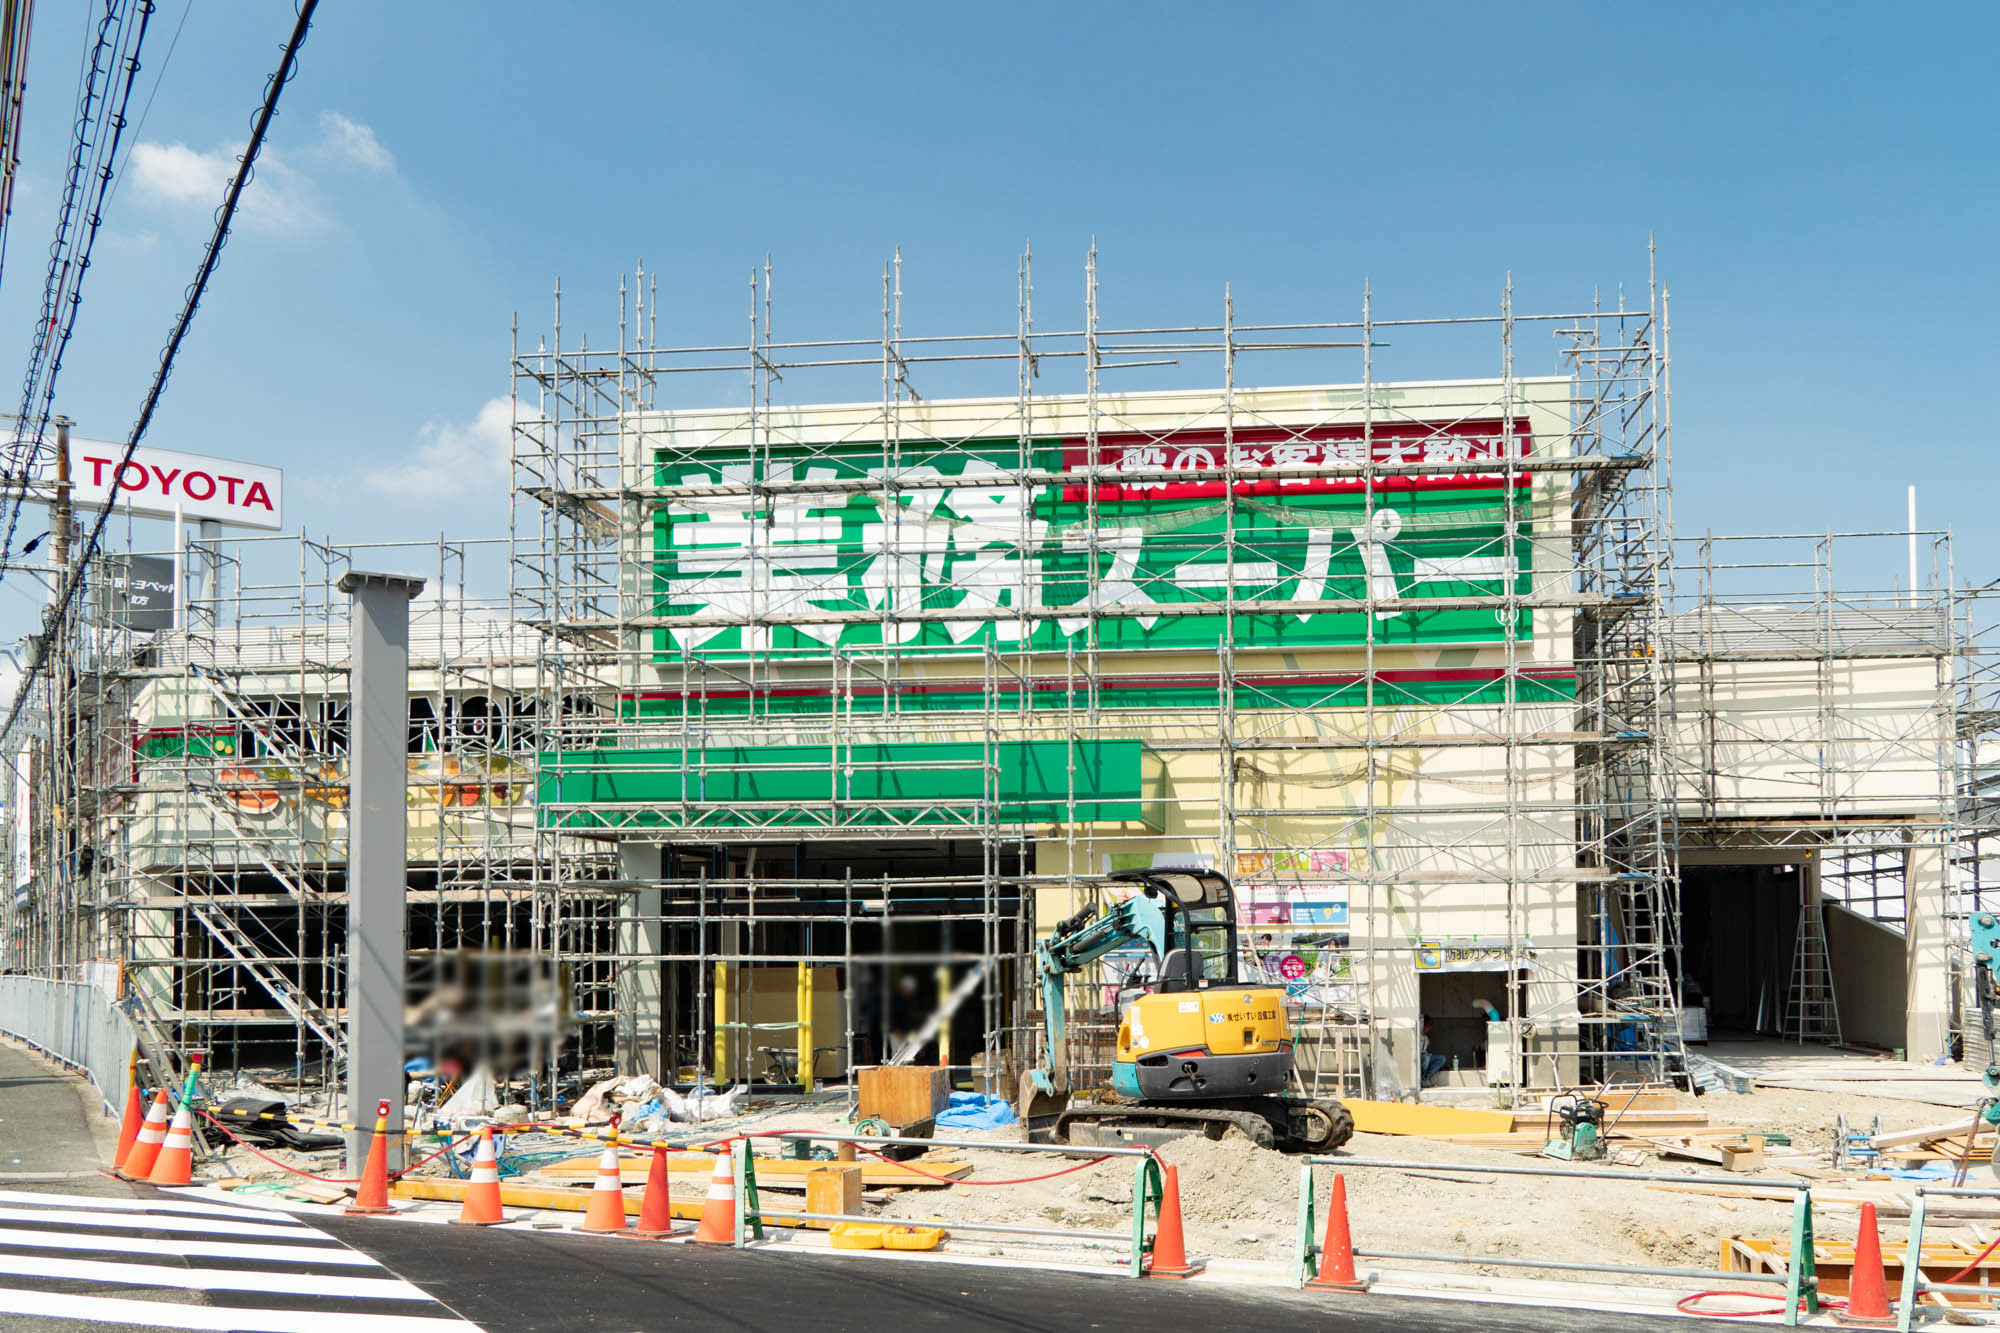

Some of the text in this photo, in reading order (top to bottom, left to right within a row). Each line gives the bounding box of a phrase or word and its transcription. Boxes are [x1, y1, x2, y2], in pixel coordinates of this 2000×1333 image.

[83, 456, 274, 512] TOYOTA
[667, 461, 1519, 650] 業務スーパー
